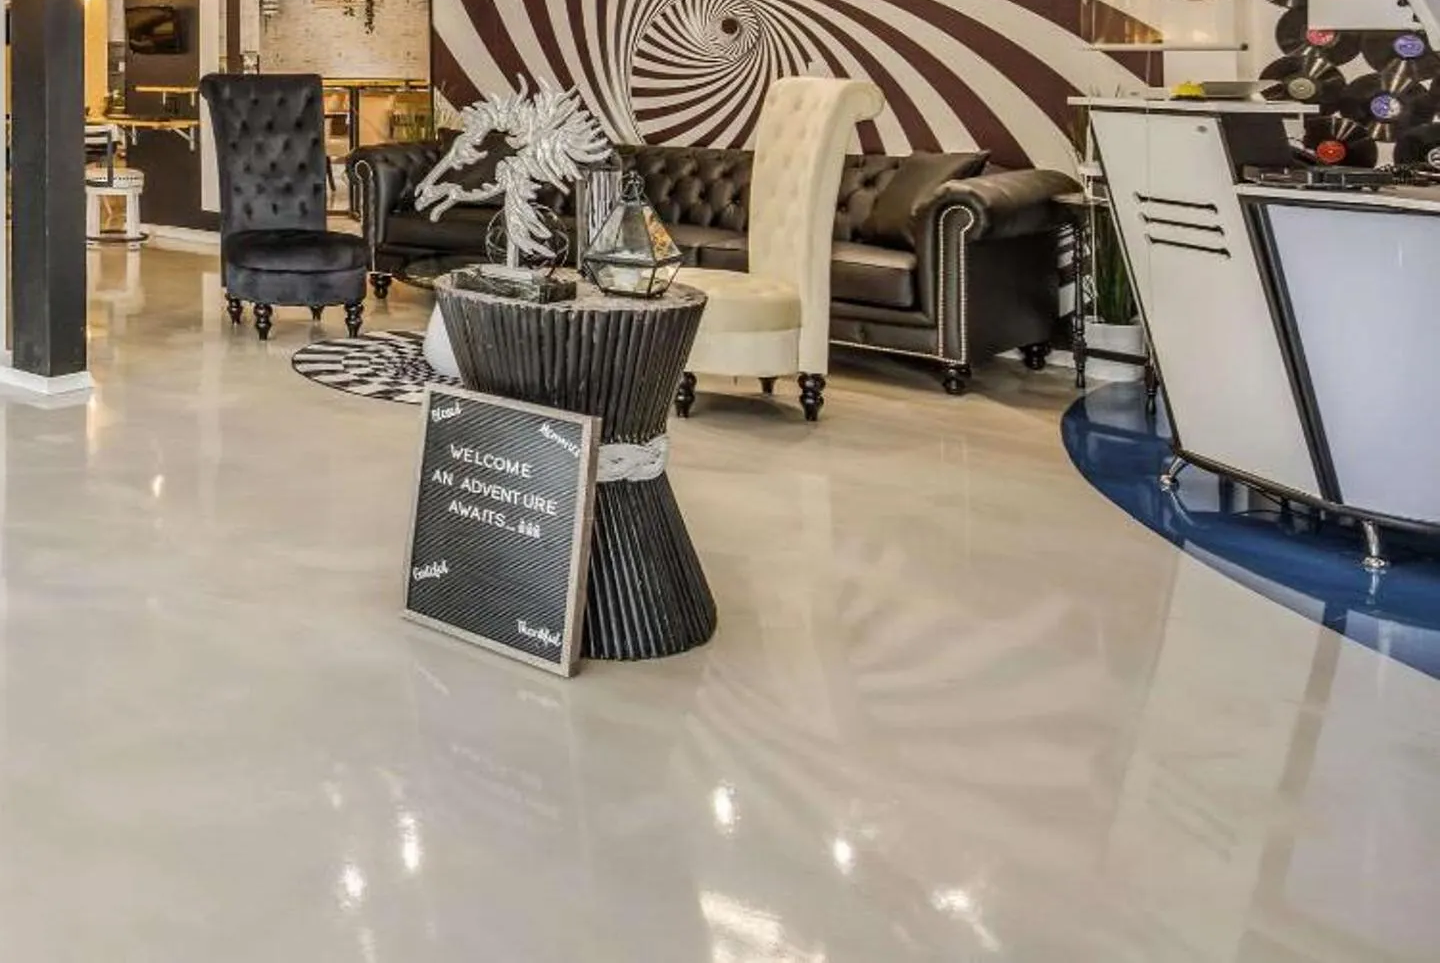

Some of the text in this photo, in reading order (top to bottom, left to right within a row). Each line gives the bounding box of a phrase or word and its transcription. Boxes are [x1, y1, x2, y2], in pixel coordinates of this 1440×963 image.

[450, 444, 532, 478] WELCOME
[431, 469, 558, 516] AN ADVENTURE
